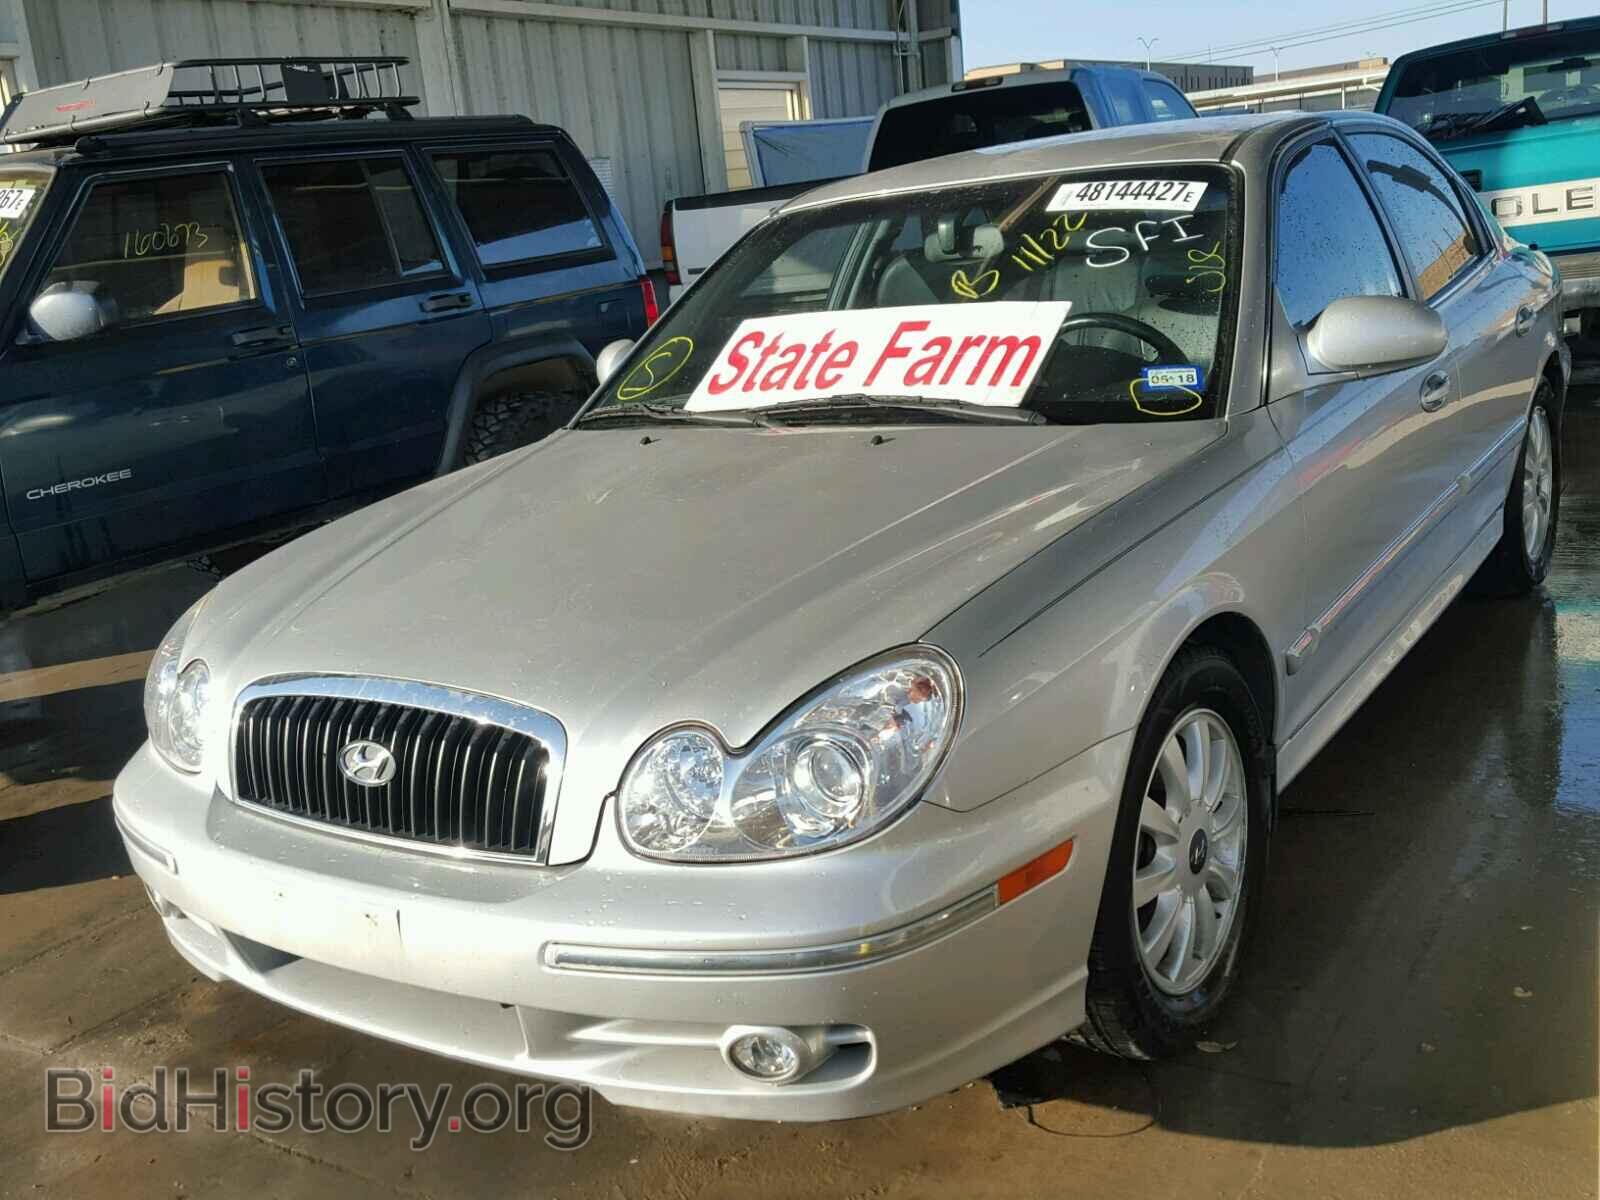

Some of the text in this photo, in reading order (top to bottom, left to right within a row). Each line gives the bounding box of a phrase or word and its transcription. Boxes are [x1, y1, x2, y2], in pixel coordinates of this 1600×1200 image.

[1076, 181, 1190, 202] 48144427
[1086, 214, 1204, 268] SFI
[707, 320, 1043, 396] State Farm
[26, 468, 132, 500] CHEROKEE
